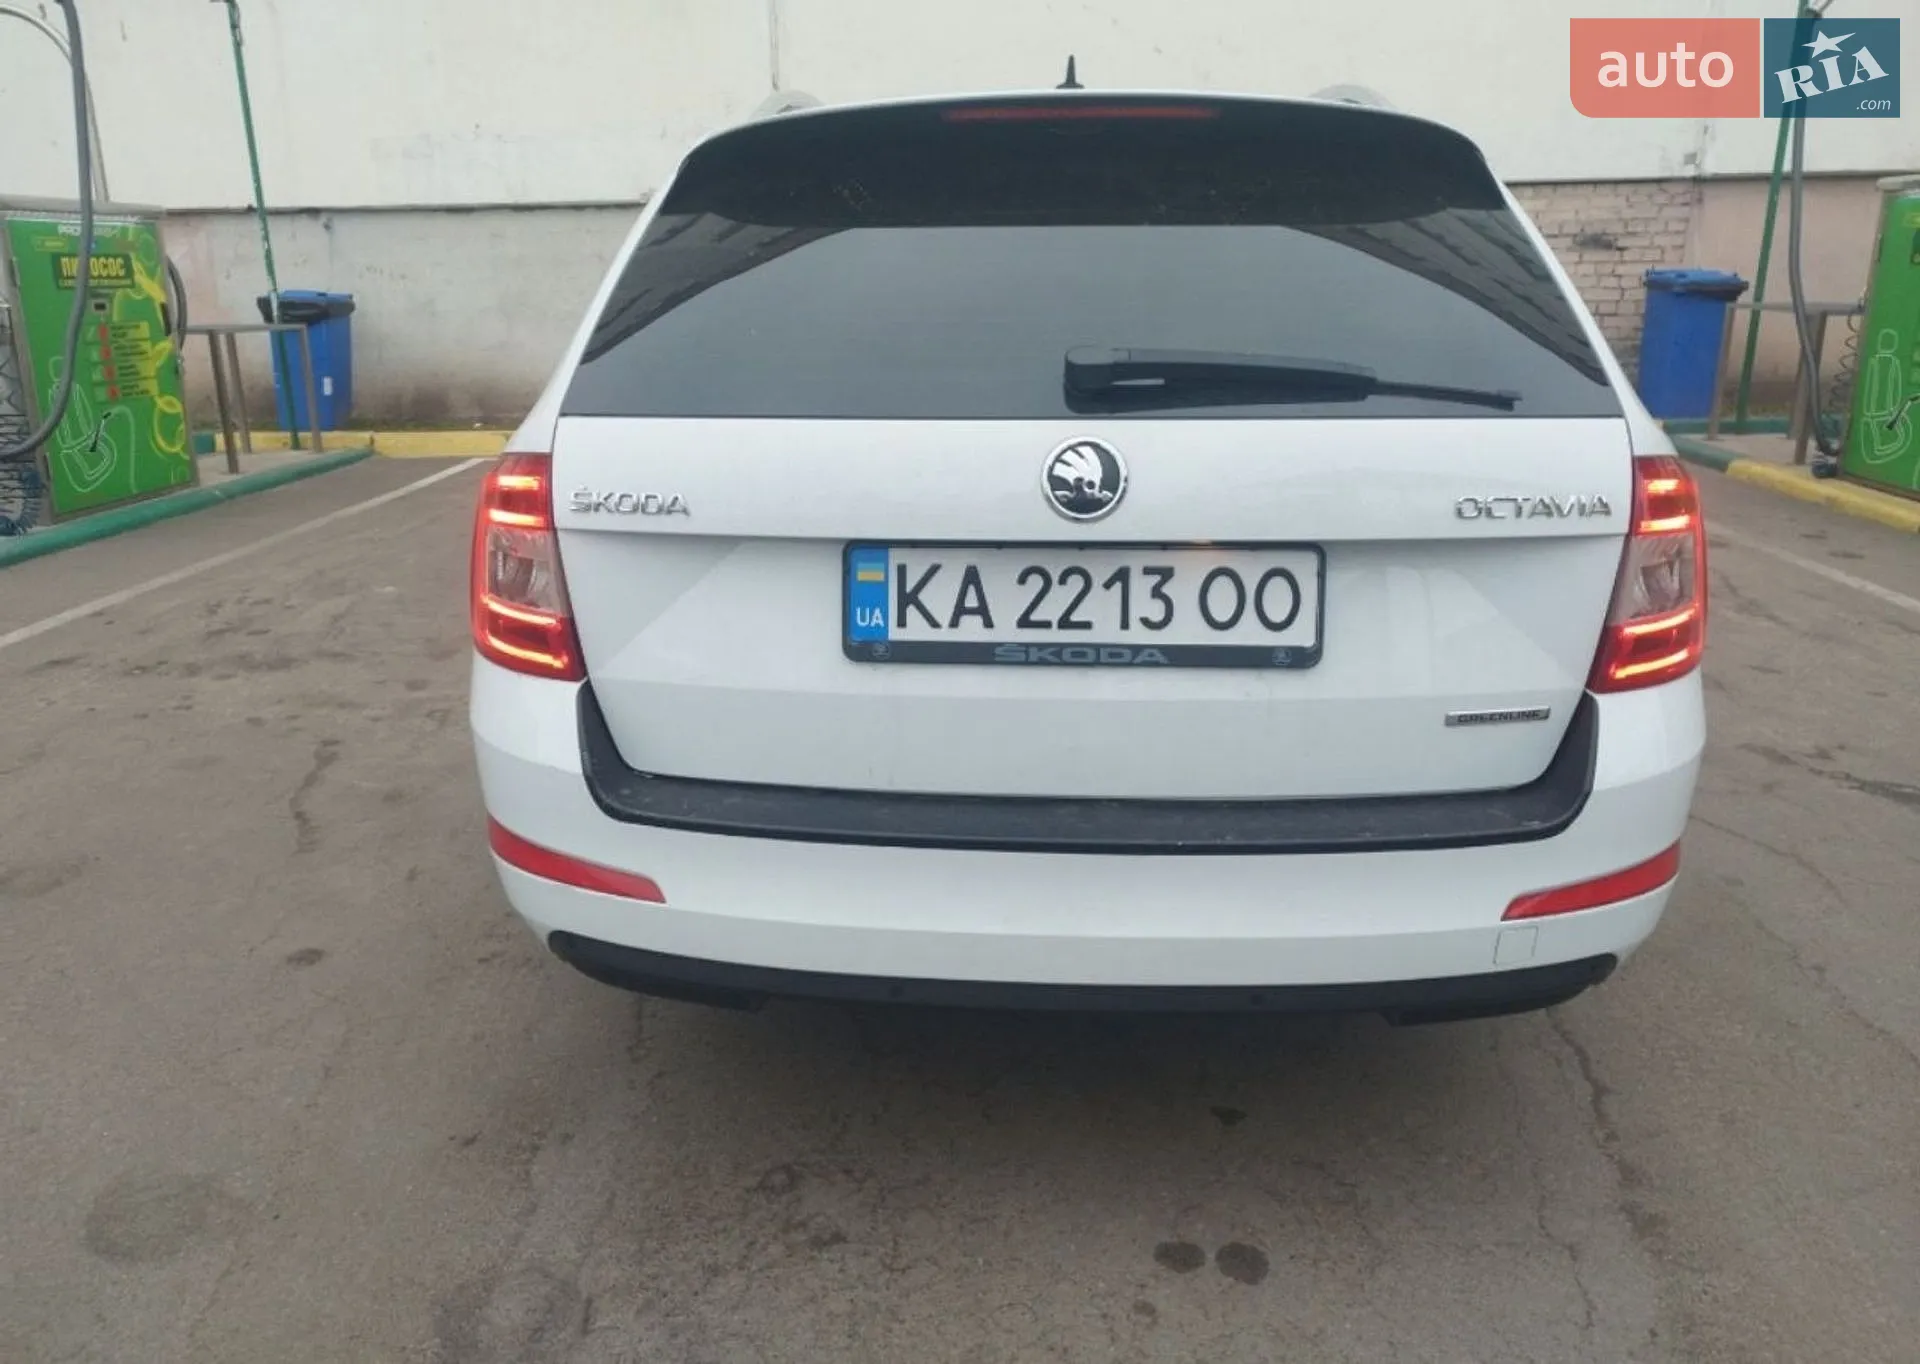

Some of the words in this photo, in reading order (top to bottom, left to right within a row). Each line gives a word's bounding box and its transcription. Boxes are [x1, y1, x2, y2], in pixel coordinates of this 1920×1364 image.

[60, 255, 125, 277] ПИОСОС
[568, 484, 691, 517] ŠKODA
[1455, 495, 1612, 520] OCTAVIA
[896, 563, 995, 629] KA
[1016, 565, 1174, 631] 2213
[1199, 566, 1301, 632] OO
[855, 606, 885, 627] UA
[994, 643, 1170, 665] ŠKODA
[1456, 709, 1543, 723] GREENLINE
